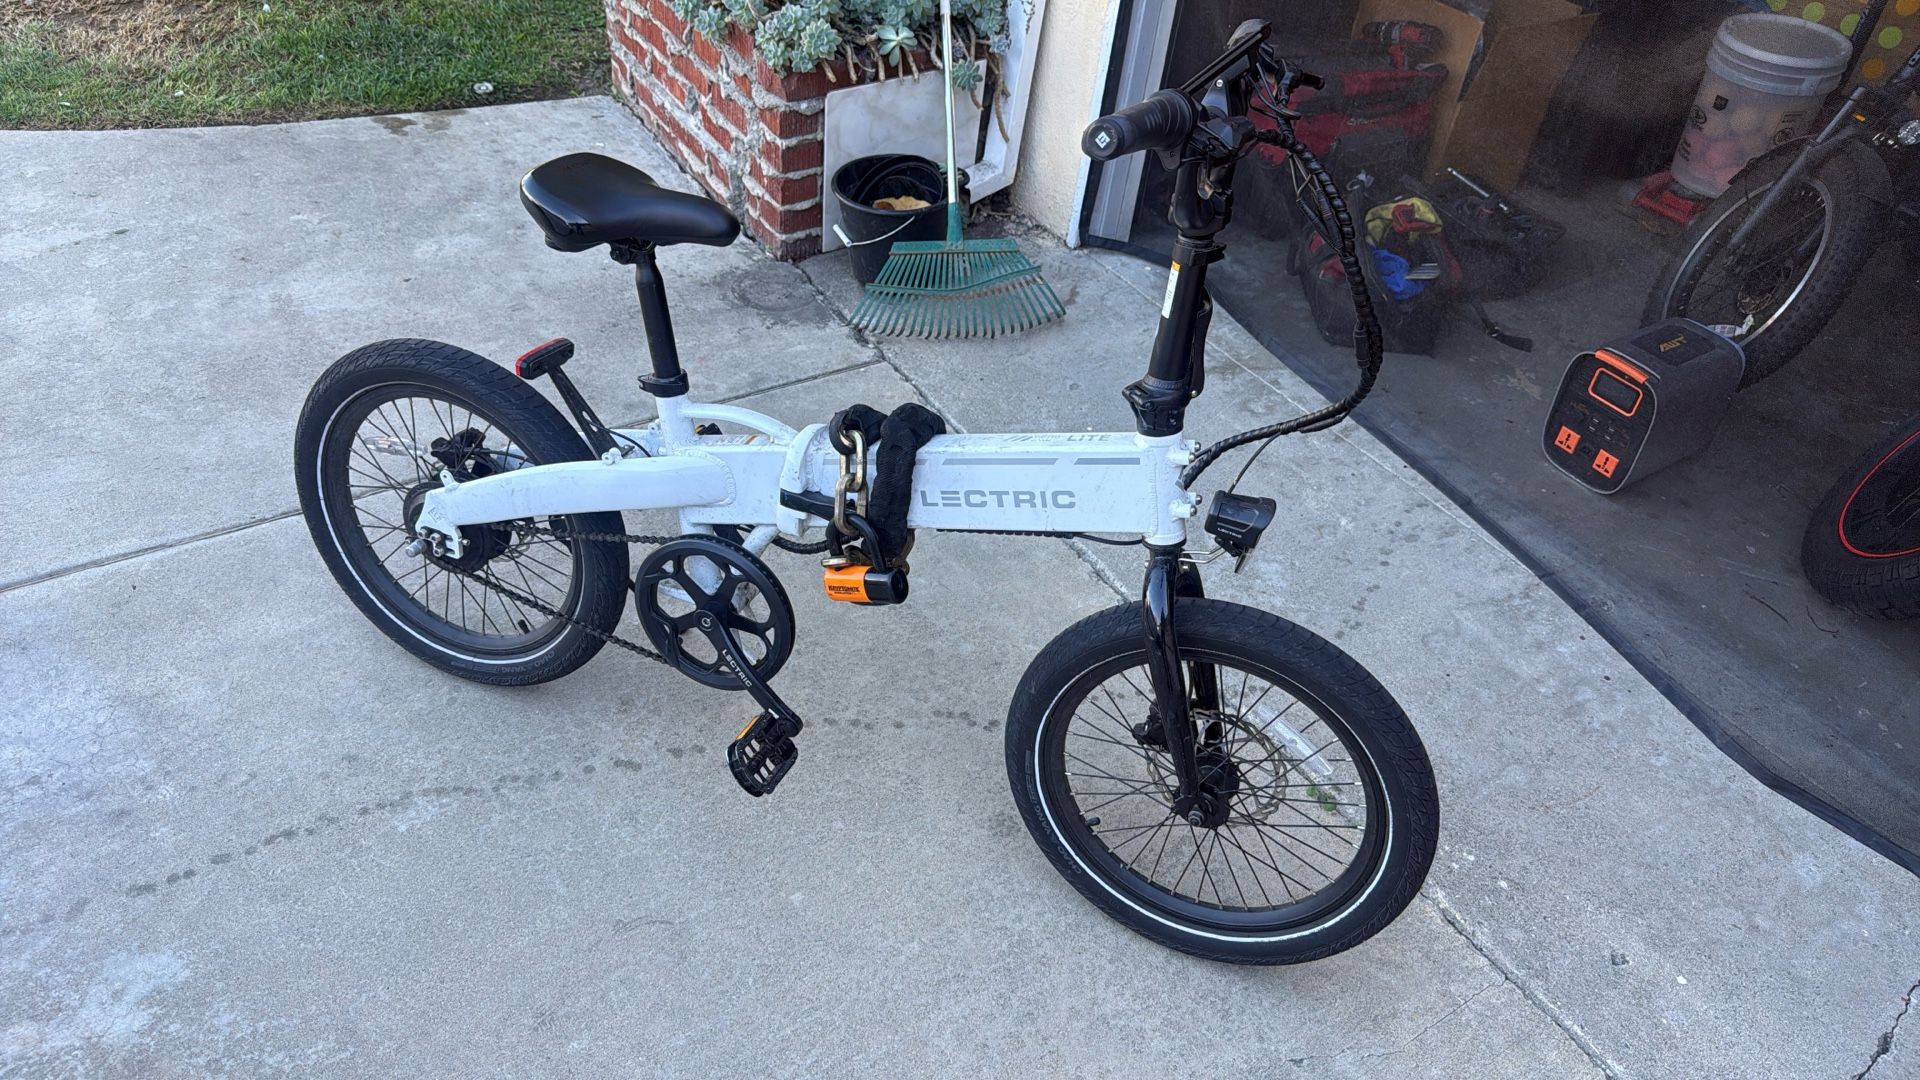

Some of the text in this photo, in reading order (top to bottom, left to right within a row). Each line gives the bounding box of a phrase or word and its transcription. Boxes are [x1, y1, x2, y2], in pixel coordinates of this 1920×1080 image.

[1066, 434, 1112, 442] LITE
[920, 490, 1076, 509] LECTRIC
[722, 649, 753, 688] LECTRIC
